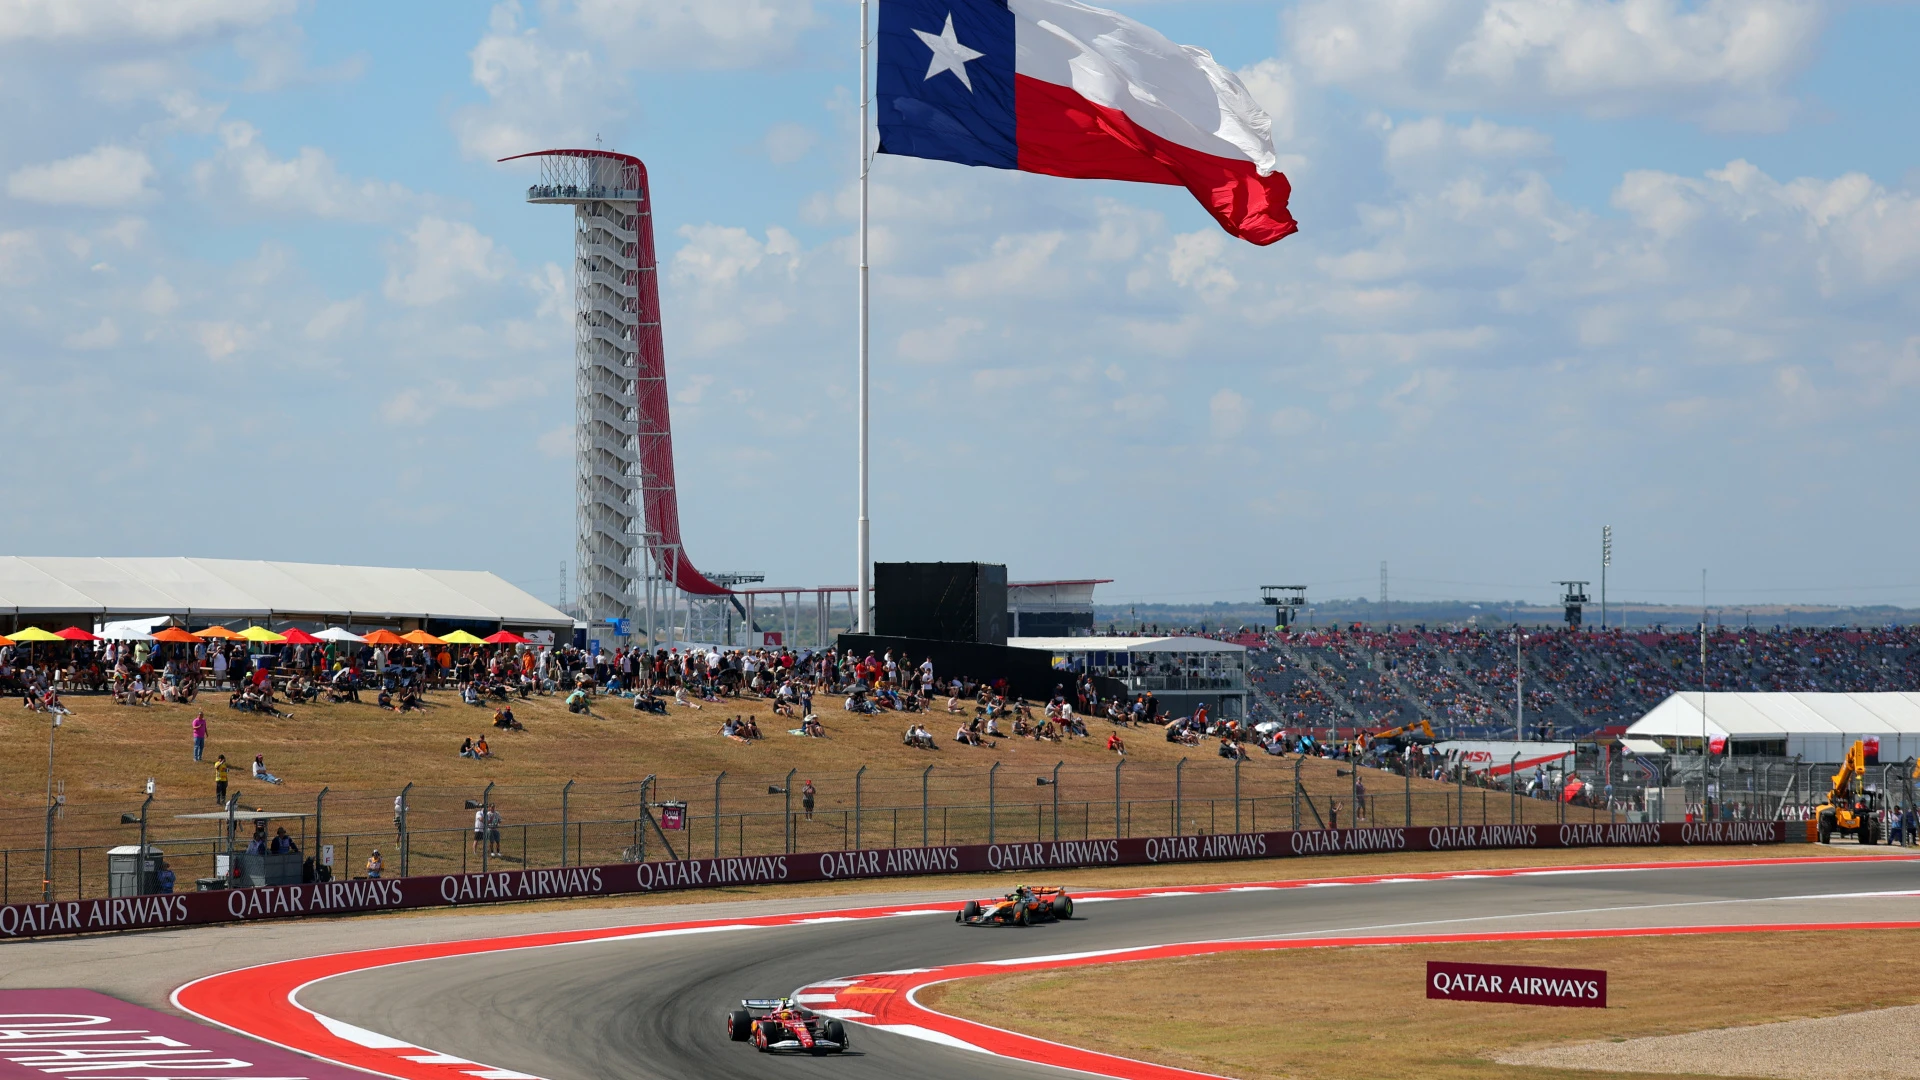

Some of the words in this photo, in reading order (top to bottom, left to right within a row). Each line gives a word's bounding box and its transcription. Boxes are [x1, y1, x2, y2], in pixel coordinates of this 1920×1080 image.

[1292, 831, 1340, 853] QATAR
[1345, 829, 1404, 849] AIRWAYS
[1430, 827, 1475, 848] QATAR
[1480, 826, 1536, 844] AIRWAYS
[1560, 824, 1602, 845] QATAR
[1608, 824, 1659, 842] AIRWAYS
[1682, 823, 1722, 843] QATAR
[1727, 823, 1774, 840] AIRWAYS
[988, 844, 1044, 869] QATAR
[1050, 841, 1118, 863] AIRWAYS
[1146, 837, 1198, 861] QATAR
[1203, 834, 1265, 856] AIRWAYS
[638, 861, 702, 889] QATAR
[708, 856, 787, 882] AIRWAYS
[820, 852, 881, 877] QATAR
[886, 848, 958, 872] AIRWAYS
[441, 873, 511, 902] QATAR
[517, 868, 602, 896] AIRWAYS
[228, 886, 303, 918] QATAR
[310, 880, 402, 910] AIRWAYS
[0, 902, 81, 935] QATAR
[88, 896, 187, 927] AIRWAYS
[1433, 973, 1503, 994] QATAR
[1509, 977, 1598, 998] AIRWAYS
